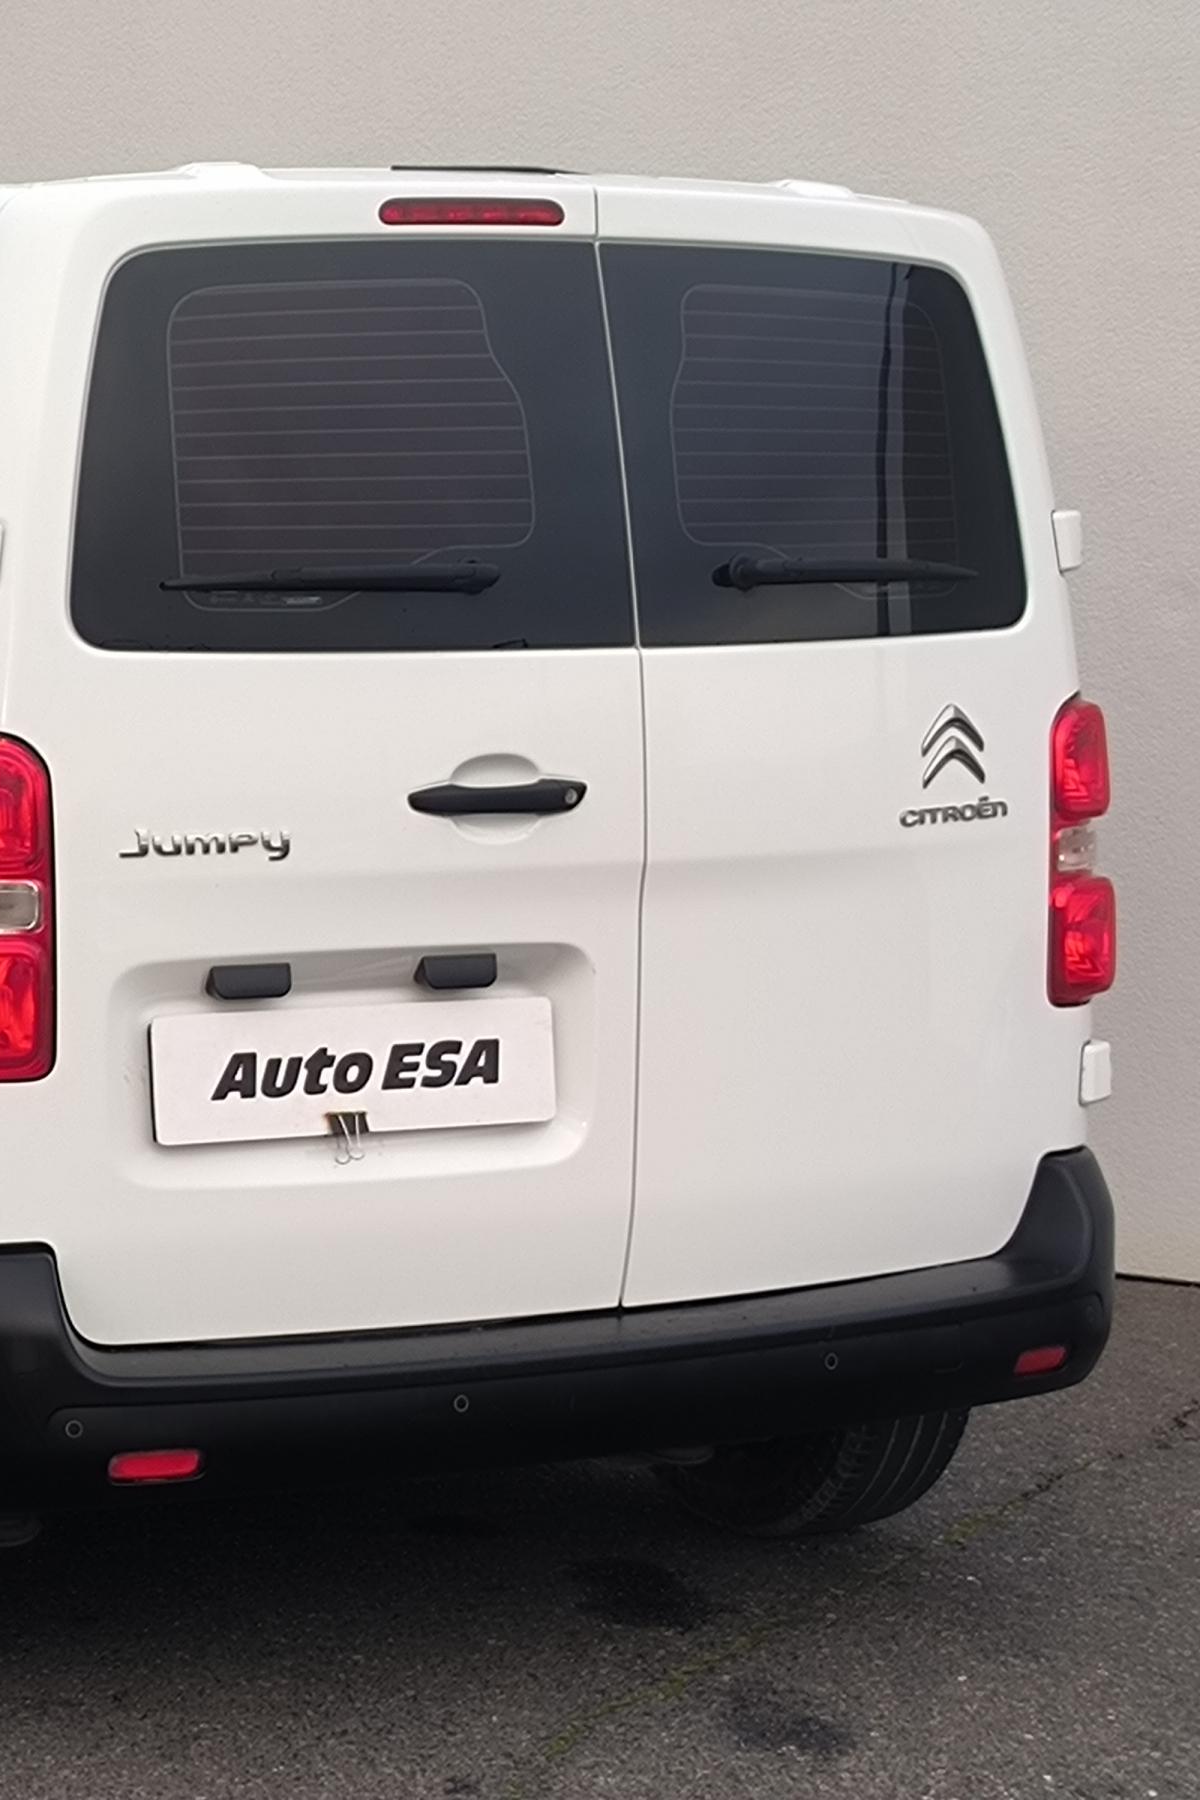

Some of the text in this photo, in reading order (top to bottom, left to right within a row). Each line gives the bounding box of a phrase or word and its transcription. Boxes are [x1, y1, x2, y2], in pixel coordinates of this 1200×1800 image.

[119, 828, 291, 862] Jumpy
[210, 1038, 500, 1102] Auto ESA
